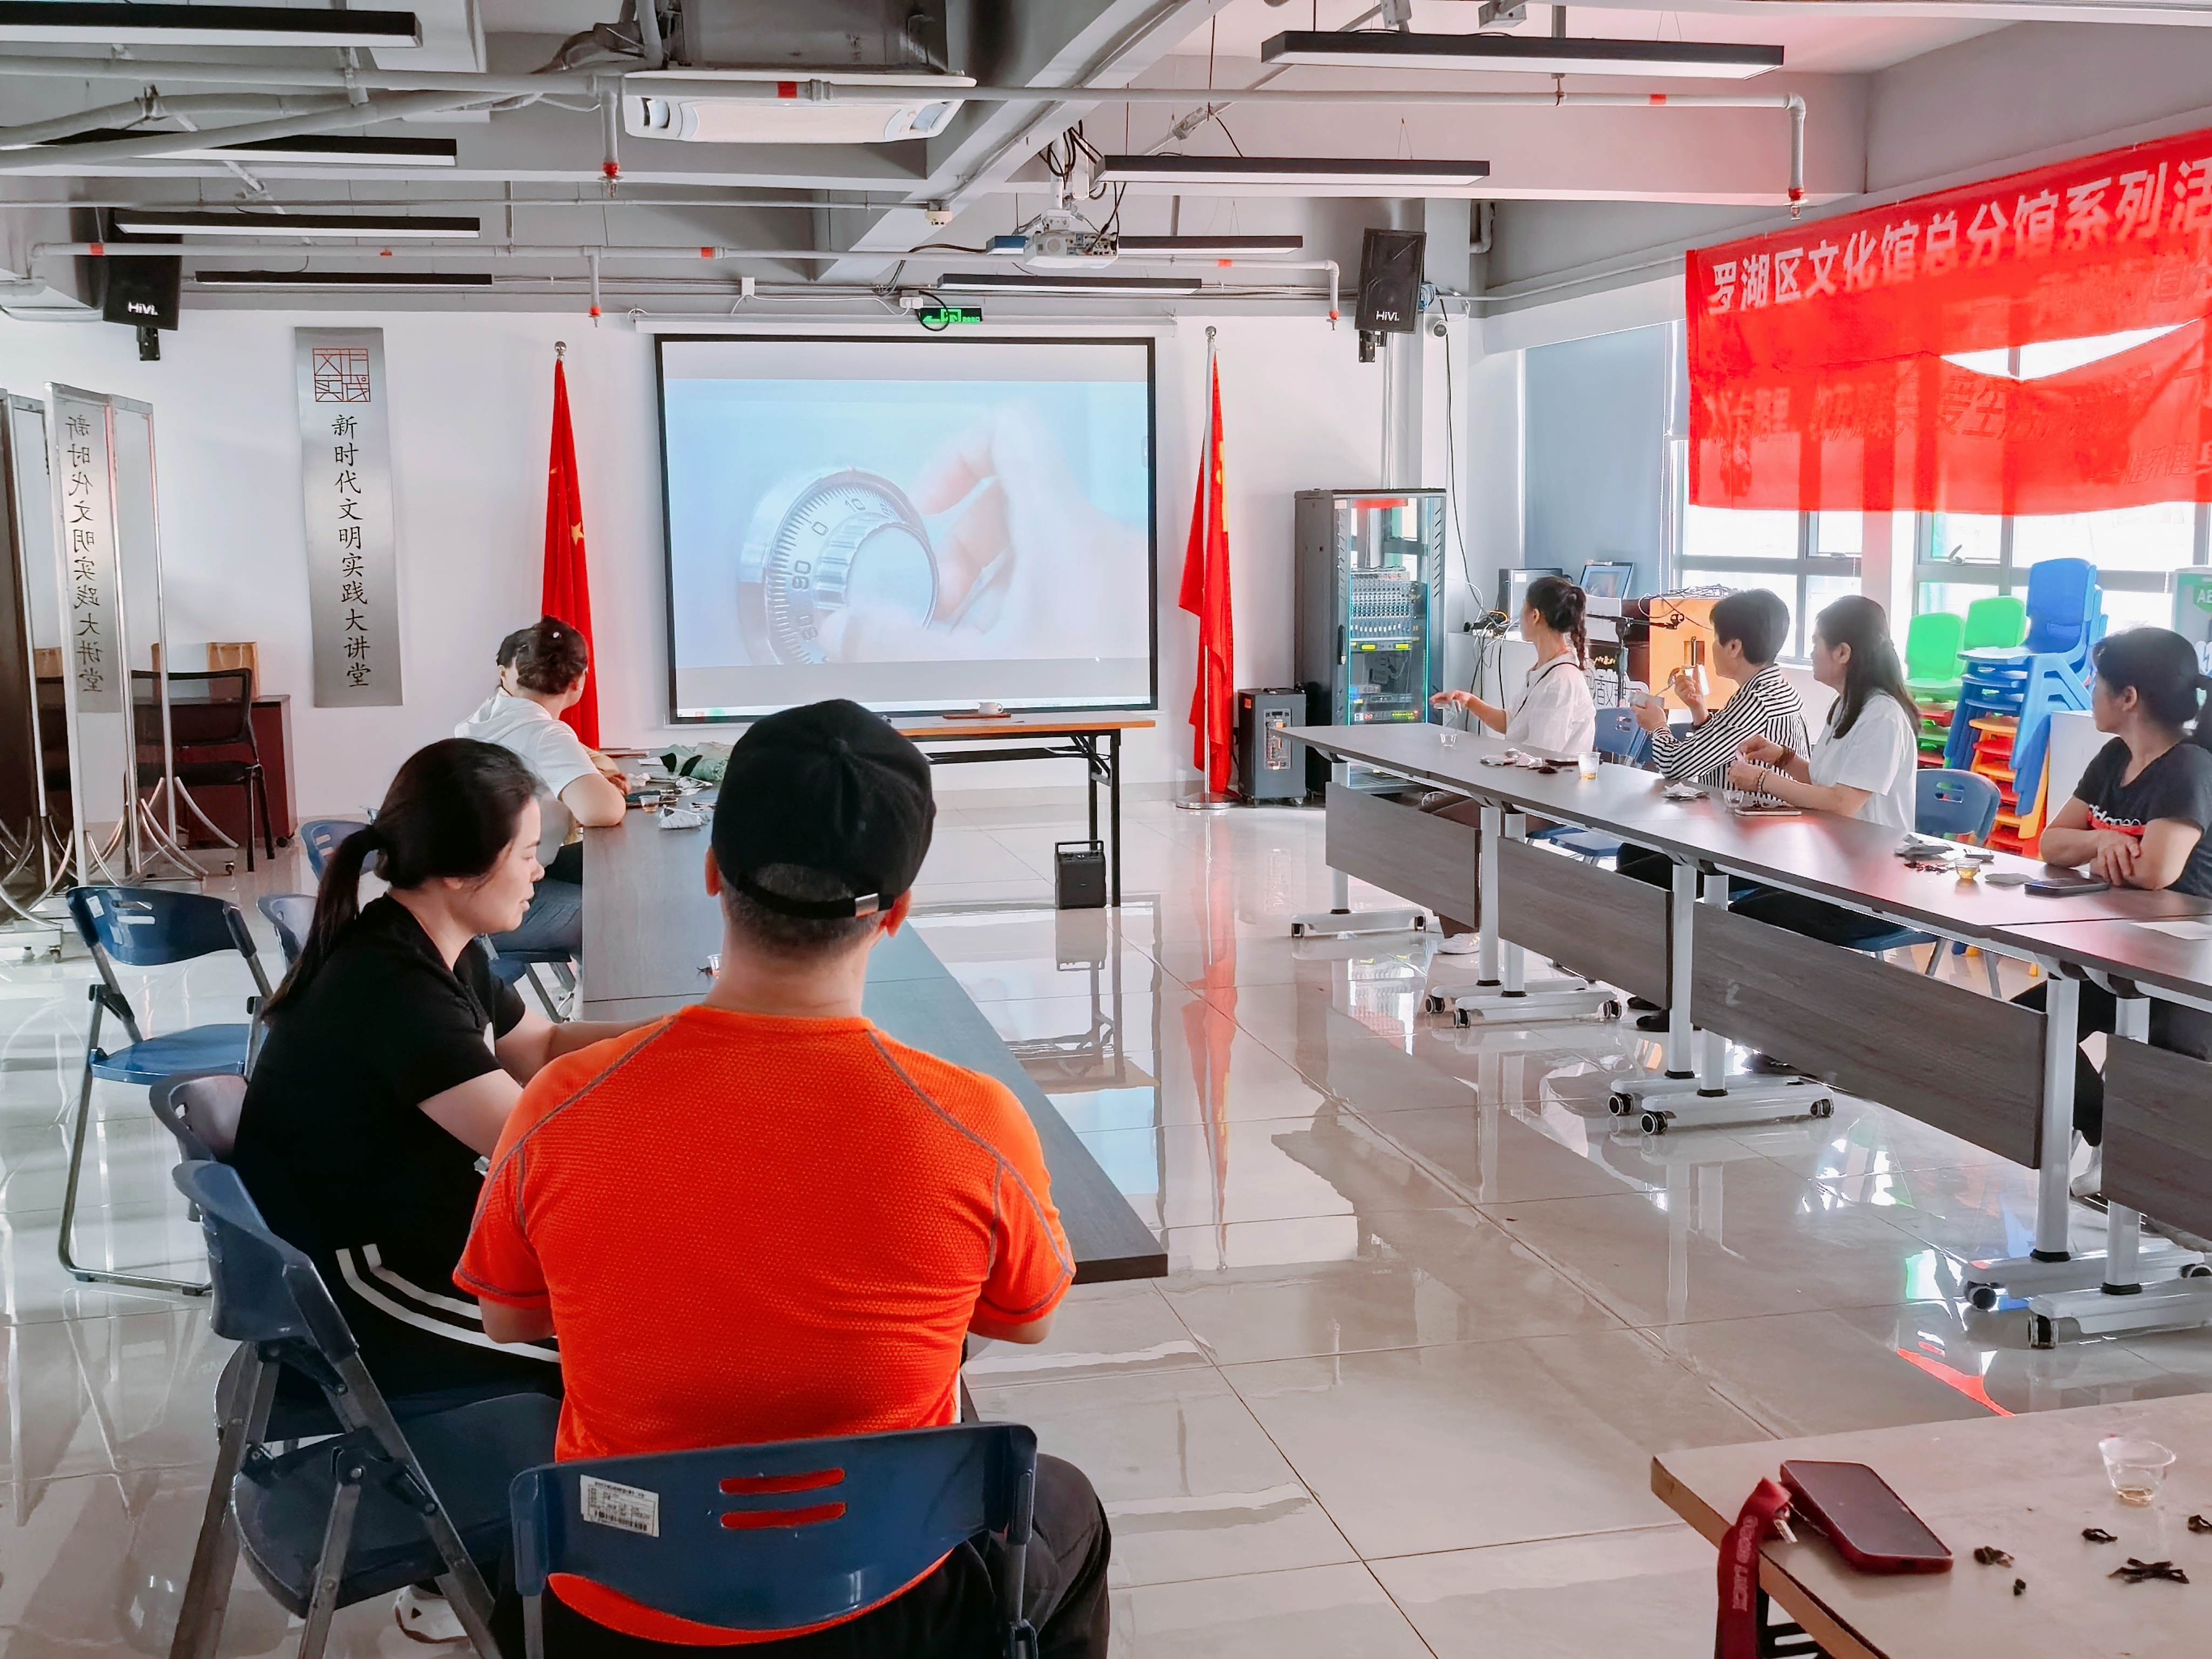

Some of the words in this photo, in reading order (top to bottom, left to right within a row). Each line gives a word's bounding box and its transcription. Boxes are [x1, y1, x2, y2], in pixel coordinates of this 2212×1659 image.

[332, 414, 371, 687] 新时代文明实践大讲堂
